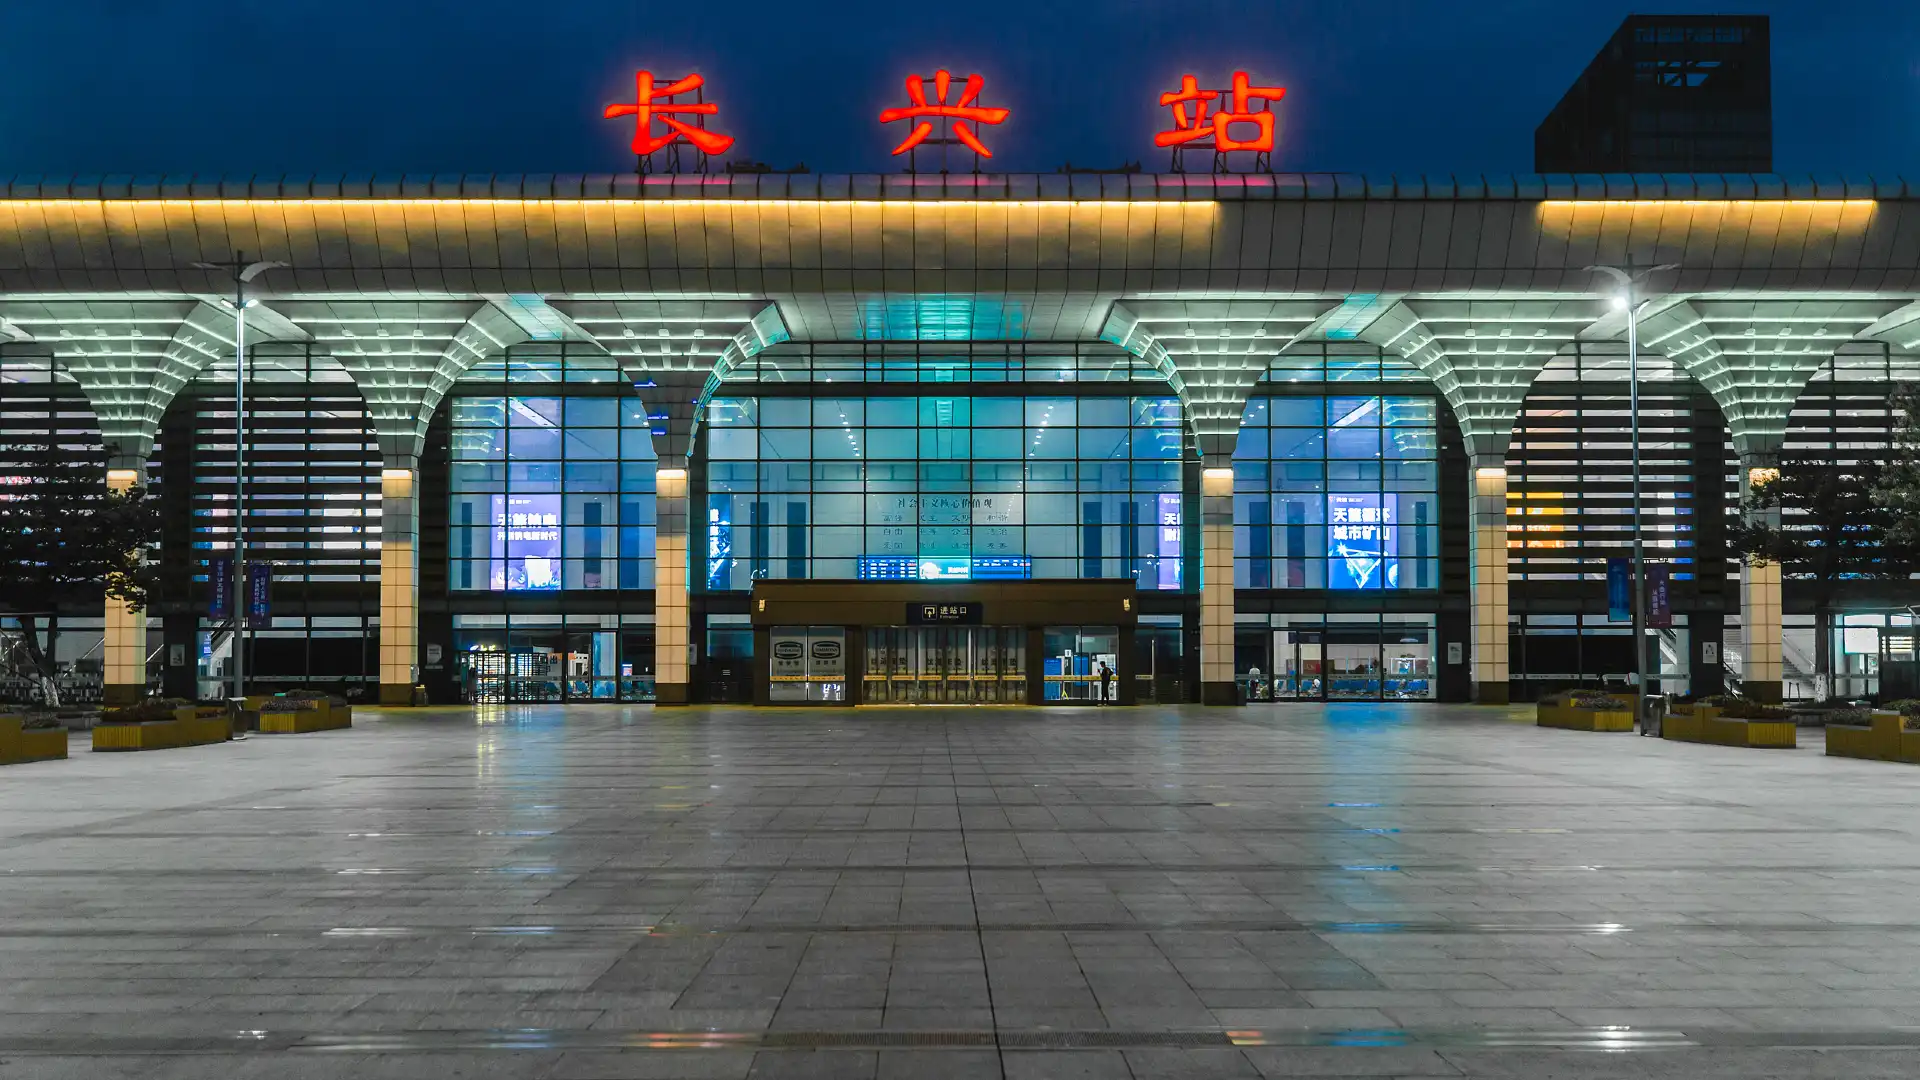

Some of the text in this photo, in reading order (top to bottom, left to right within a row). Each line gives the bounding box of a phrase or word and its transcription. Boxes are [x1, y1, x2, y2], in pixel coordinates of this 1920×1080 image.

[603, 69, 1286, 158] 长兴站
[940, 606, 967, 615] 进站口
